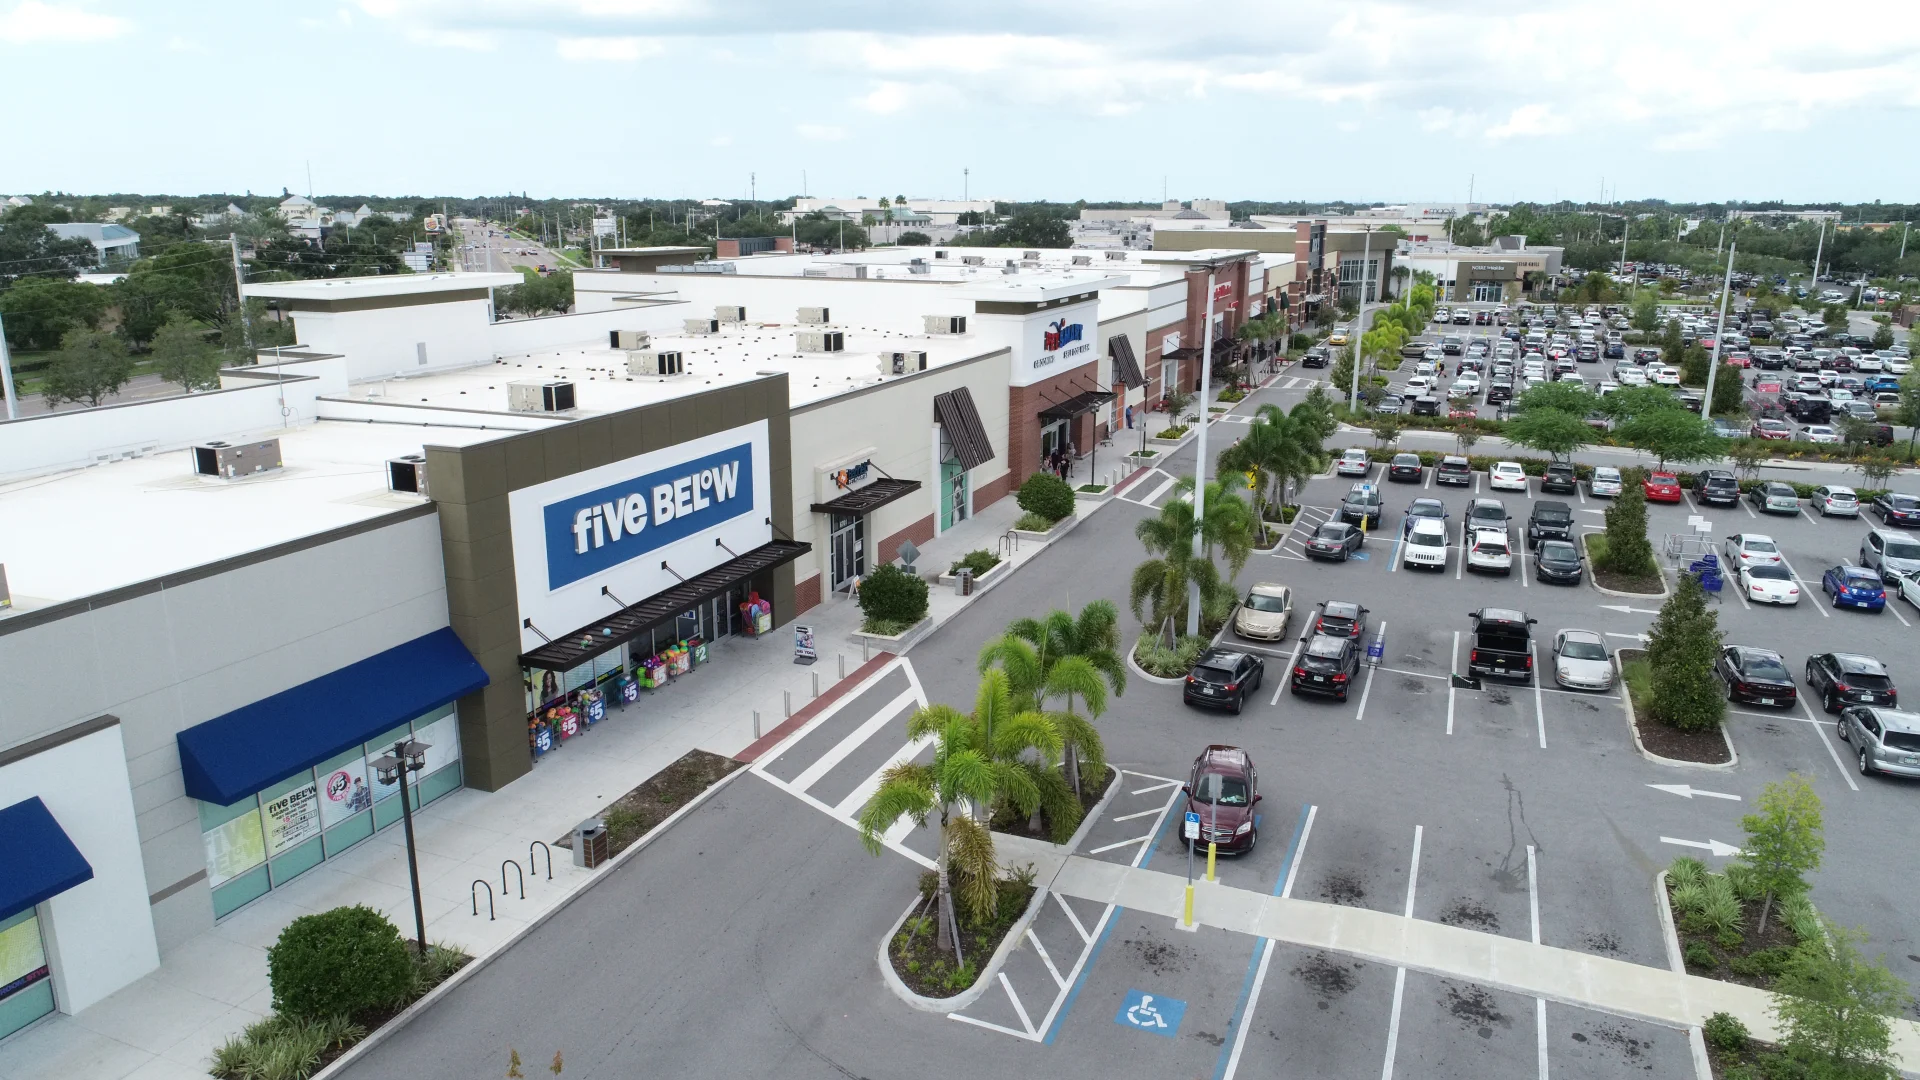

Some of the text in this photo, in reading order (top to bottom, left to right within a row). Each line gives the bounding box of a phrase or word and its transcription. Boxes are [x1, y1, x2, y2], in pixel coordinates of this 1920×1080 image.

[571, 460, 740, 555] five BELOW
[695, 645, 707, 662] $2
[624, 683, 638, 701] $5
[589, 702, 604, 720] $5
[562, 716, 578, 735] $5
[537, 732, 551, 751] $5
[268, 785, 317, 814] five BELOW
